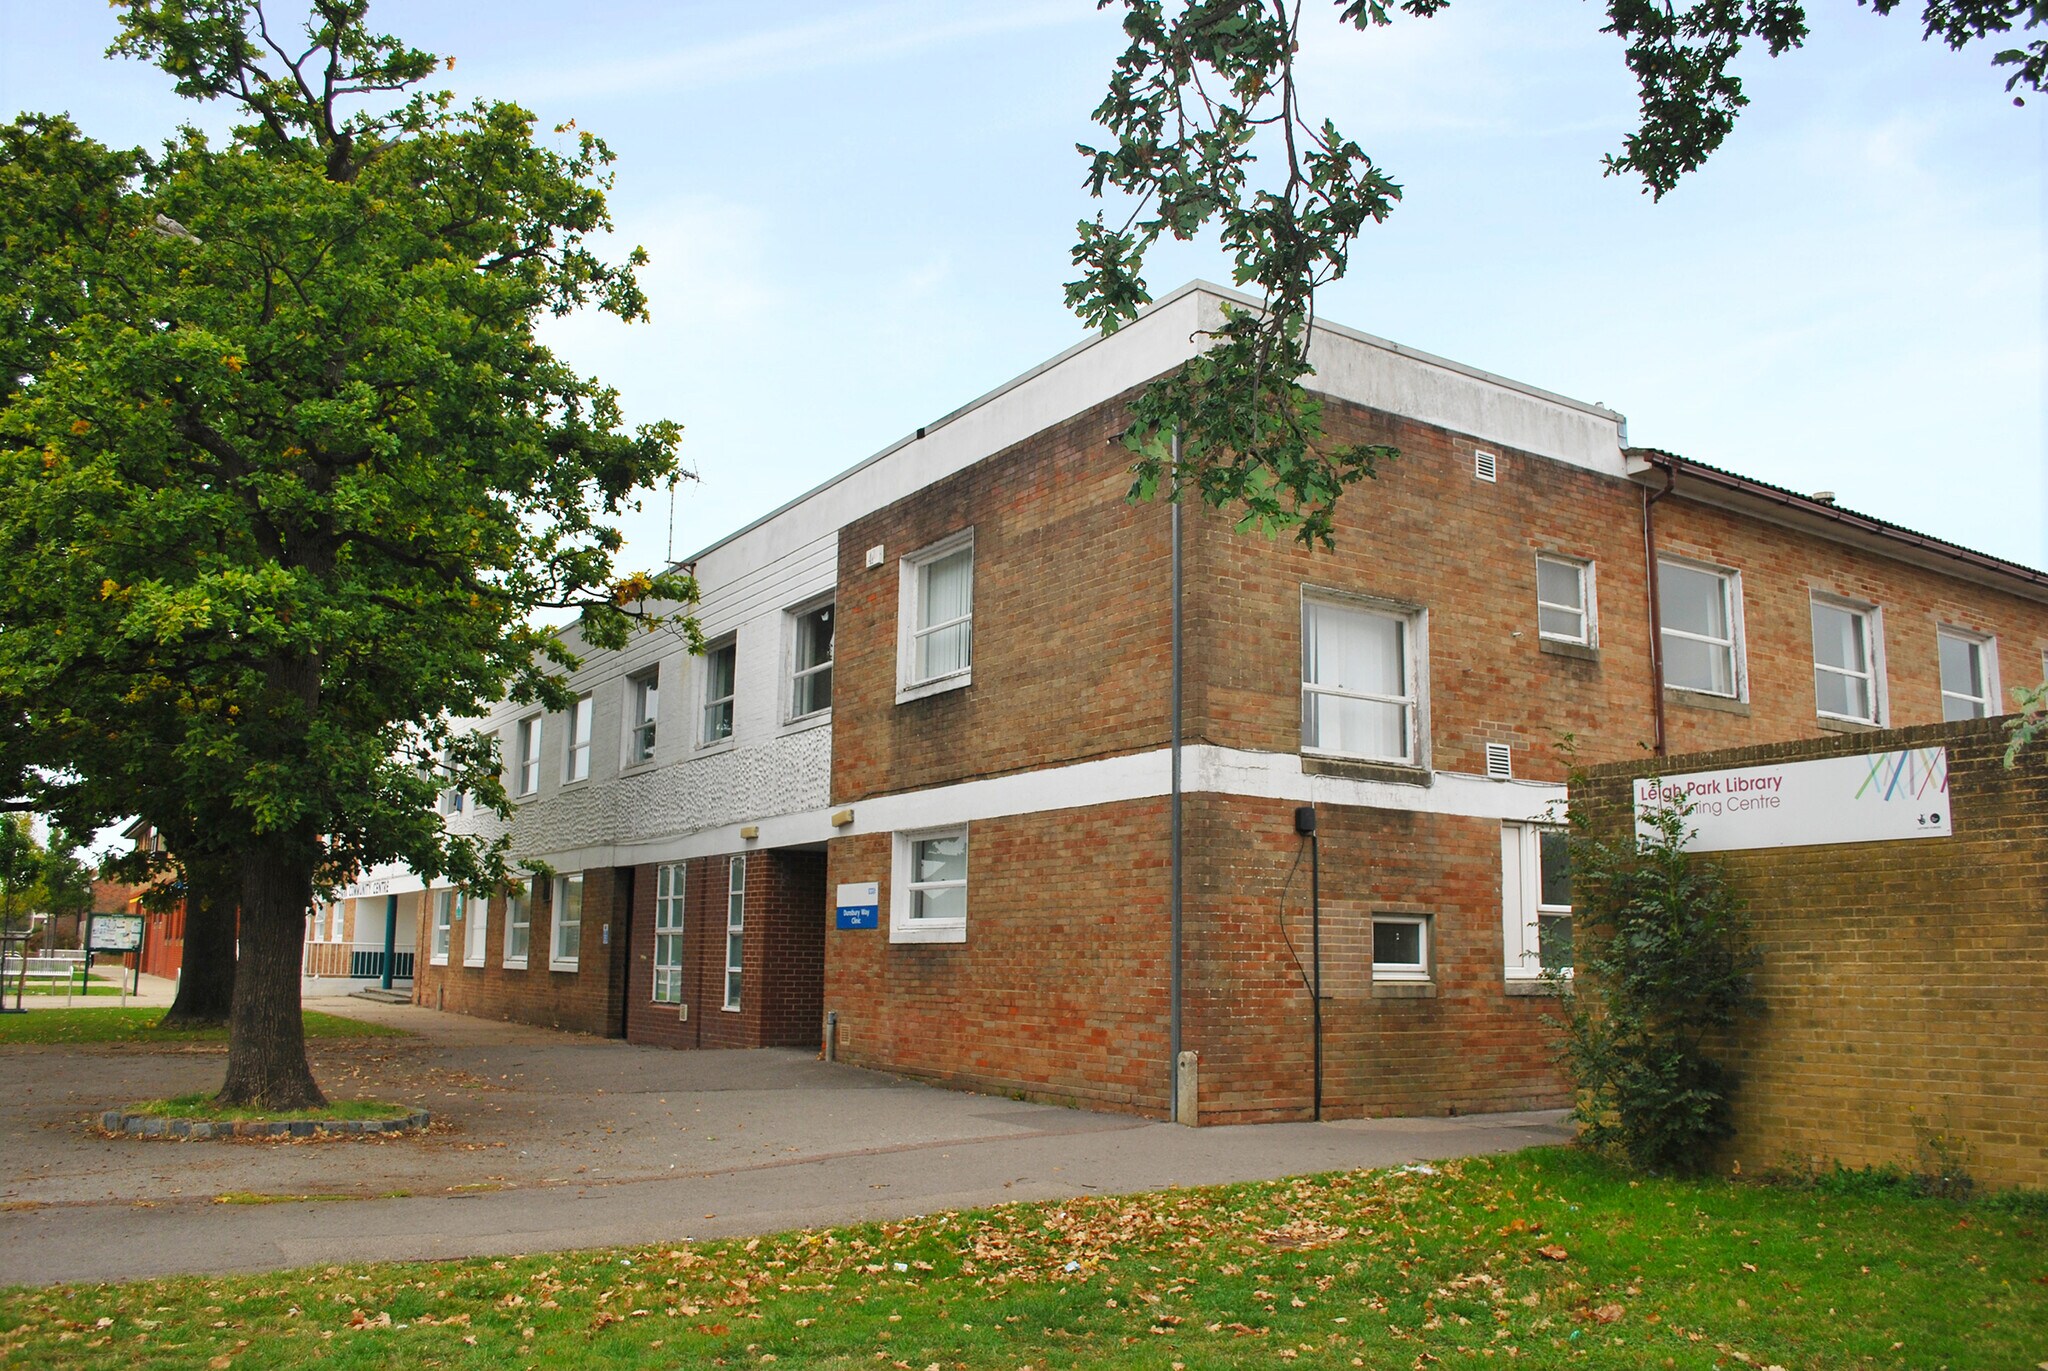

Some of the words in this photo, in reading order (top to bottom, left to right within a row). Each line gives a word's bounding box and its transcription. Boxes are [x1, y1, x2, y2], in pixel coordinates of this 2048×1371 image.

[1641, 783, 1682, 803] Leigh
[1687, 780, 1720, 796] Park
[1726, 776, 1782, 792] Library
[1726, 795, 1780, 812] Centre
